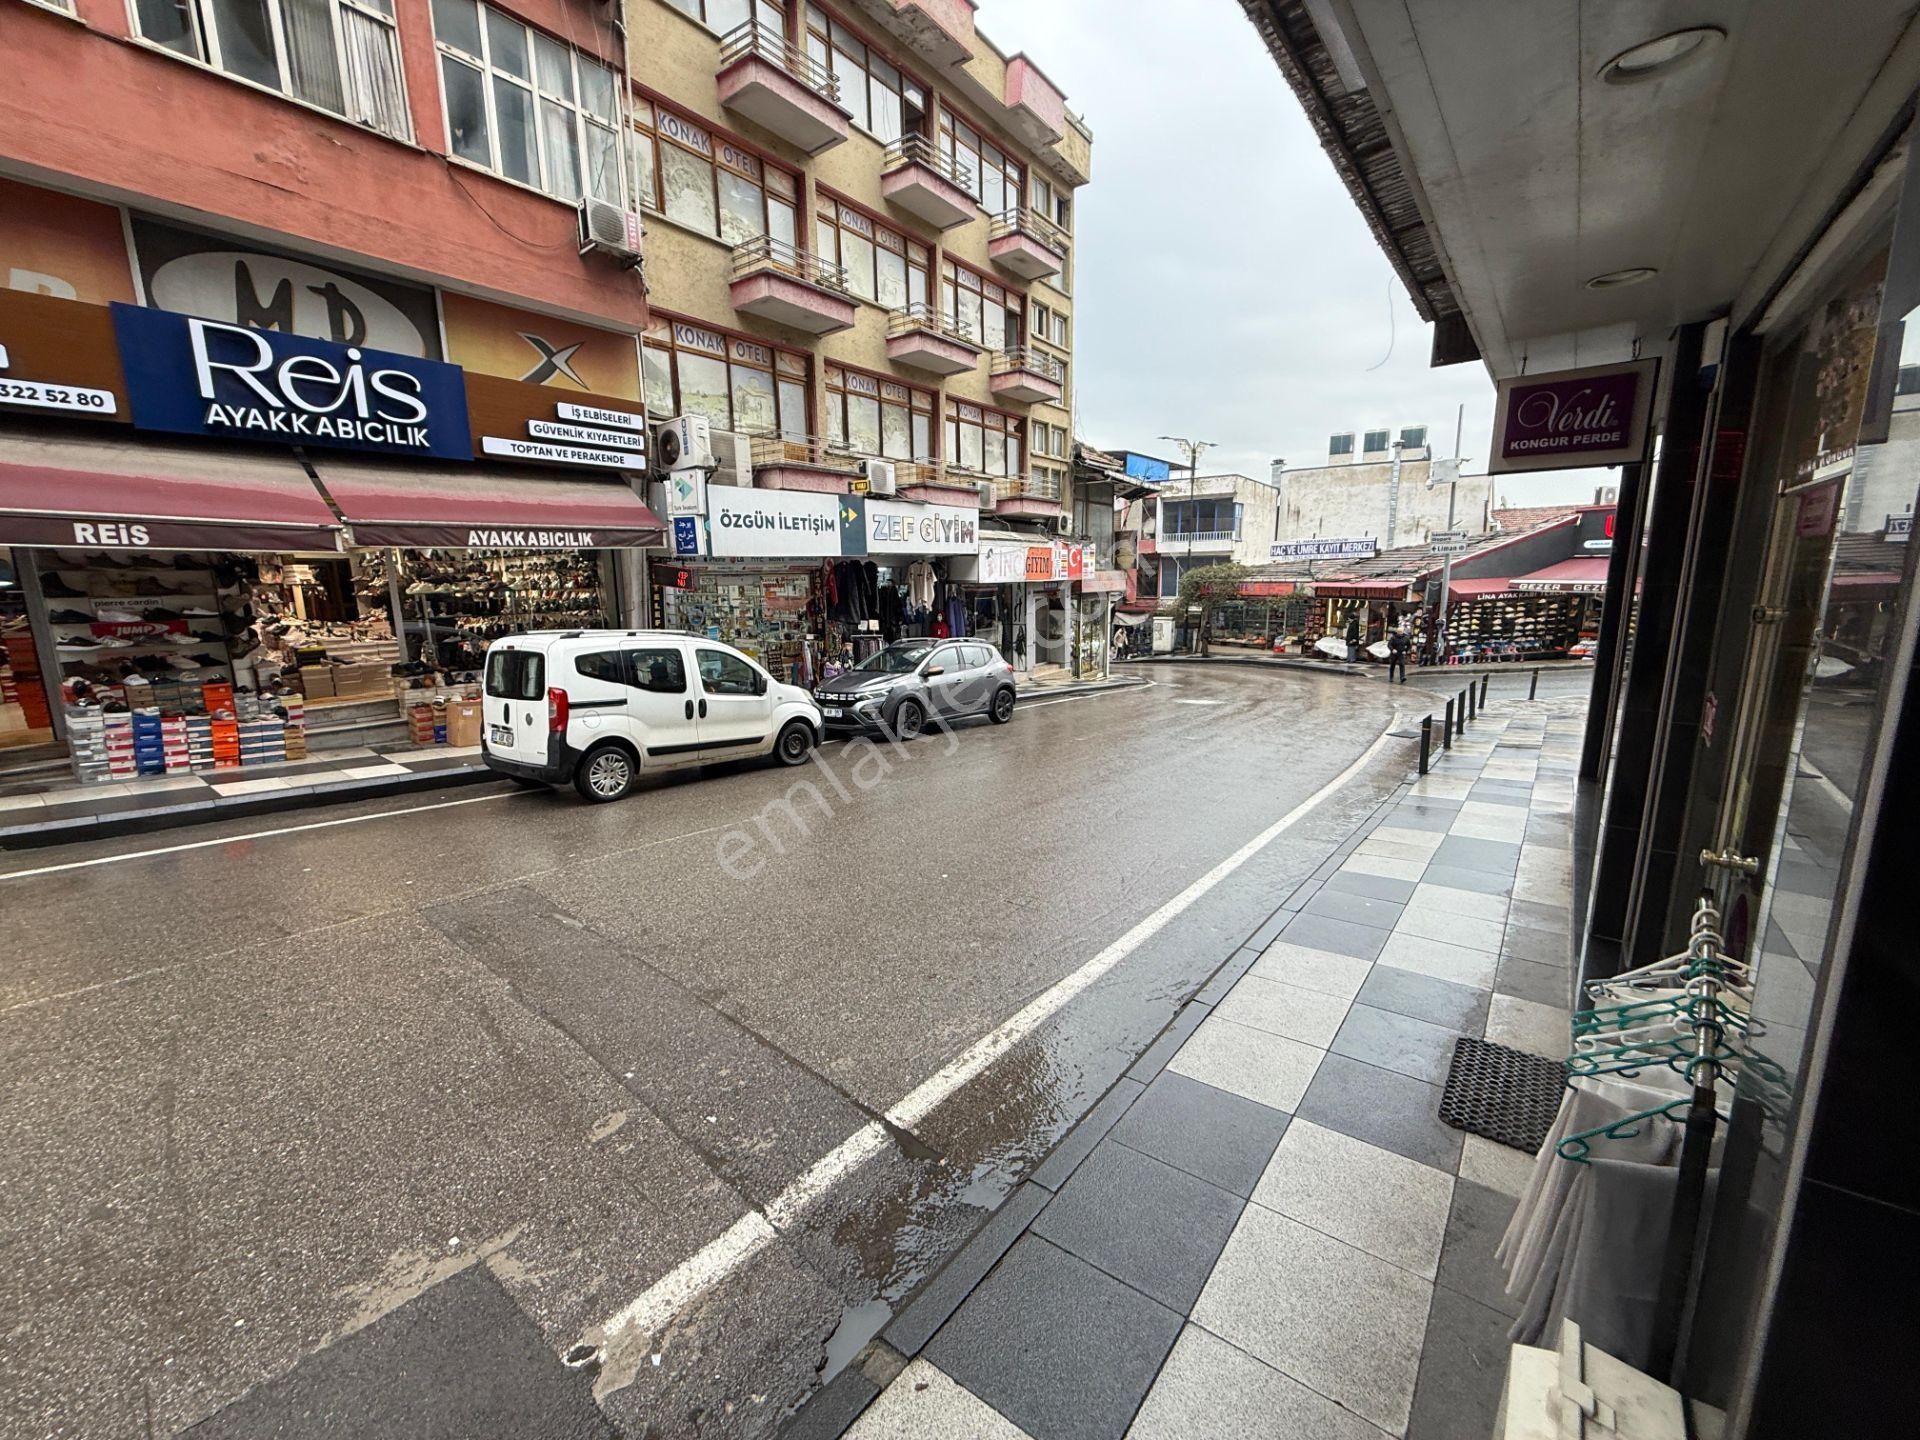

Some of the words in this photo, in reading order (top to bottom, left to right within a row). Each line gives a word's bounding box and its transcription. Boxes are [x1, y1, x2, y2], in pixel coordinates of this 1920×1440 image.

[658, 111, 711, 154] KONAK
[723, 146, 757, 176] OTEL
[628, 215, 639, 249] VESTEL
[840, 207, 872, 236] KONAK
[880, 230, 905, 252] OTEL
[674, 324, 725, 354] KONAK
[735, 342, 768, 364] OTEL
[188, 318, 428, 424] Reis
[46, 388, 71, 404] 52
[77, 393, 104, 407] 80
[846, 375, 878, 394] KONAK
[885, 383, 908, 400] OTEL
[571, 405, 581, 419] İŞ
[583, 409, 632, 426] ELBİSELERİ
[1517, 388, 1616, 433] Verdi
[206, 402, 431, 448] AYAKKABICILIK
[533, 421, 585, 439] GÜVENLİK
[586, 430, 641, 447] KIYAFETLERİ
[681, 418, 690, 456] BEKO
[510, 442, 553, 457] TOPTAN
[556, 448, 569, 458] VE
[571, 450, 625, 464] PERAKENDE
[1509, 436, 1569, 450] KONGUR
[1572, 431, 1622, 444] PERDE
[719, 508, 775, 530] ÖZGÜN
[778, 511, 836, 535] İLETİŞİM
[872, 513, 915, 542] ZEF
[919, 512, 975, 544] GİYİM
[467, 529, 594, 547] AYAKKABICILIK
[1270, 545, 1286, 556] HAC
[1286, 544, 1297, 555] VE
[1319, 542, 1341, 554] KAYIT
[1518, 583, 1561, 591] GEZER
[94, 599, 125, 608] pierre
[127, 598, 159, 606] cardin
[116, 625, 154, 637] JUMP
